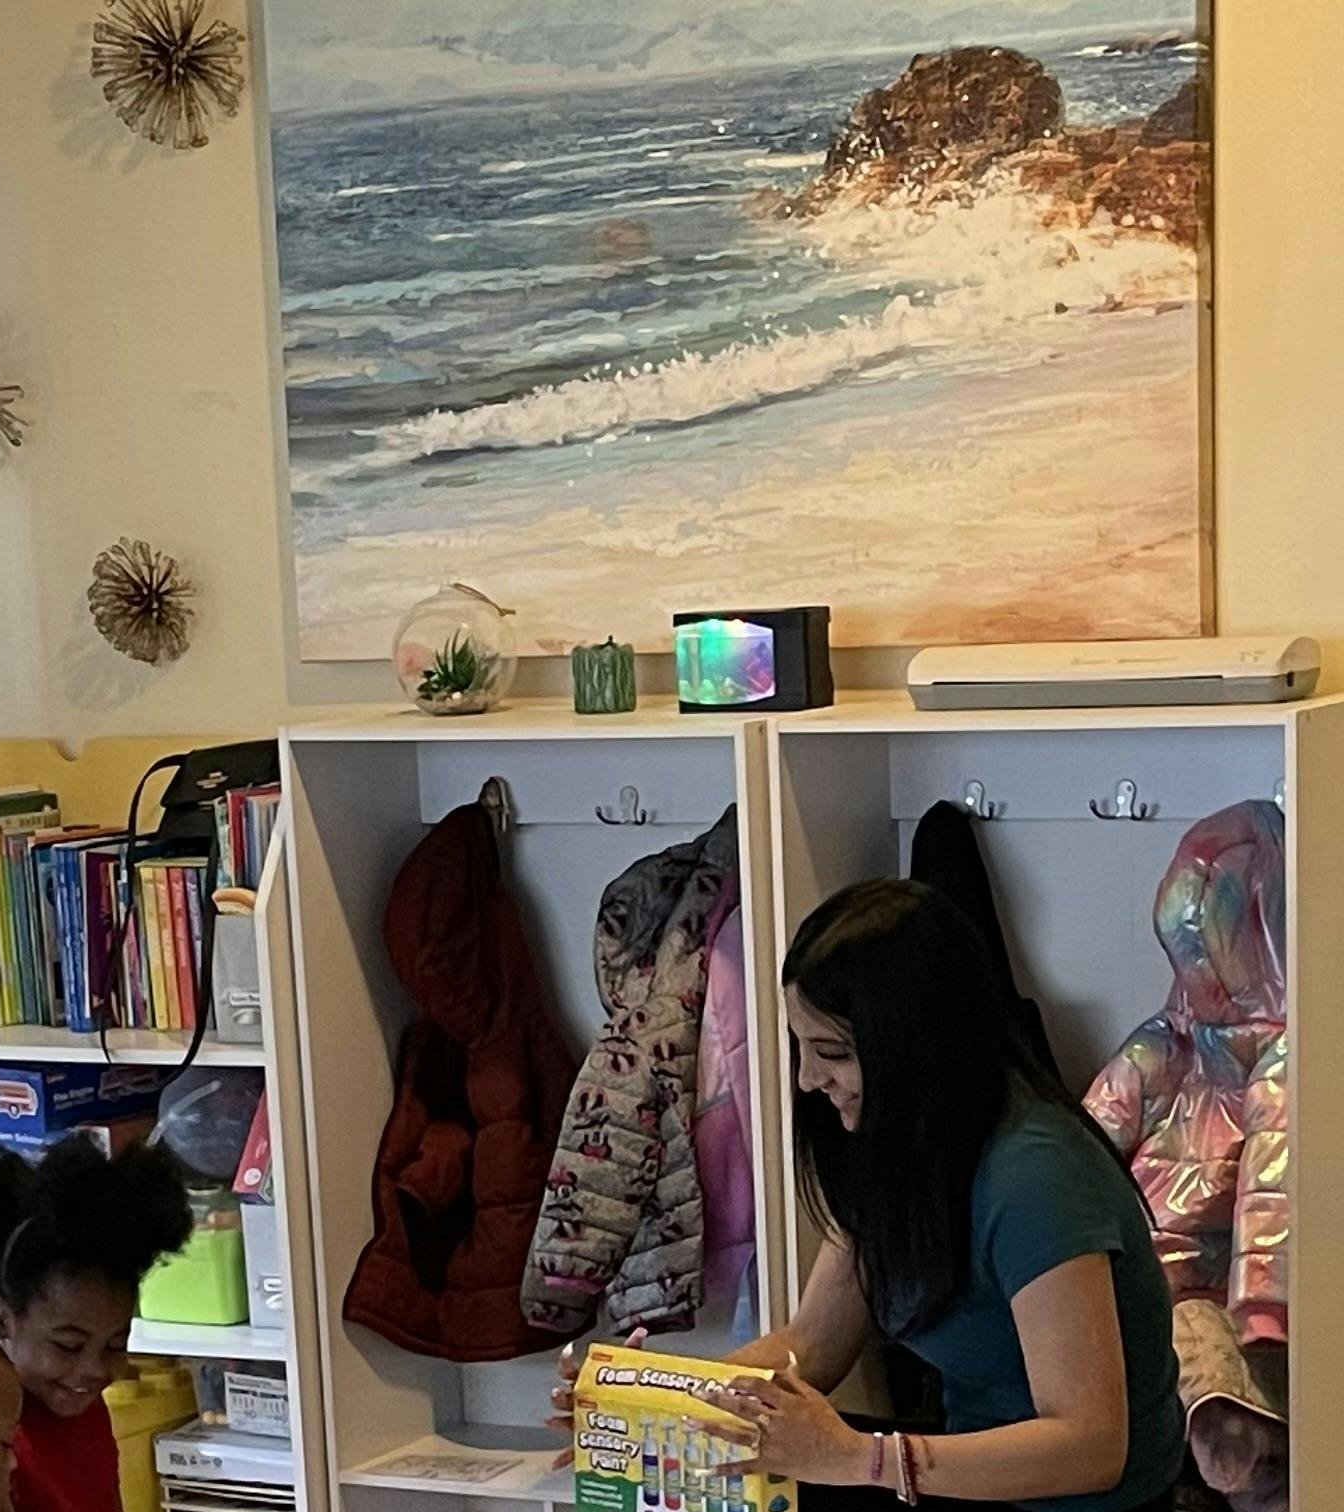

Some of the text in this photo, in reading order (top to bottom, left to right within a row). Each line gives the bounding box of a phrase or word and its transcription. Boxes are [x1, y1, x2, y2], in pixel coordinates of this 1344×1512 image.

[597, 1367, 638, 1386] Foam
[639, 1367, 703, 1394] Sensory
[587, 1411, 628, 1435] Foam
[578, 1431, 640, 1458] Sensory
[590, 1452, 629, 1473] Paint
